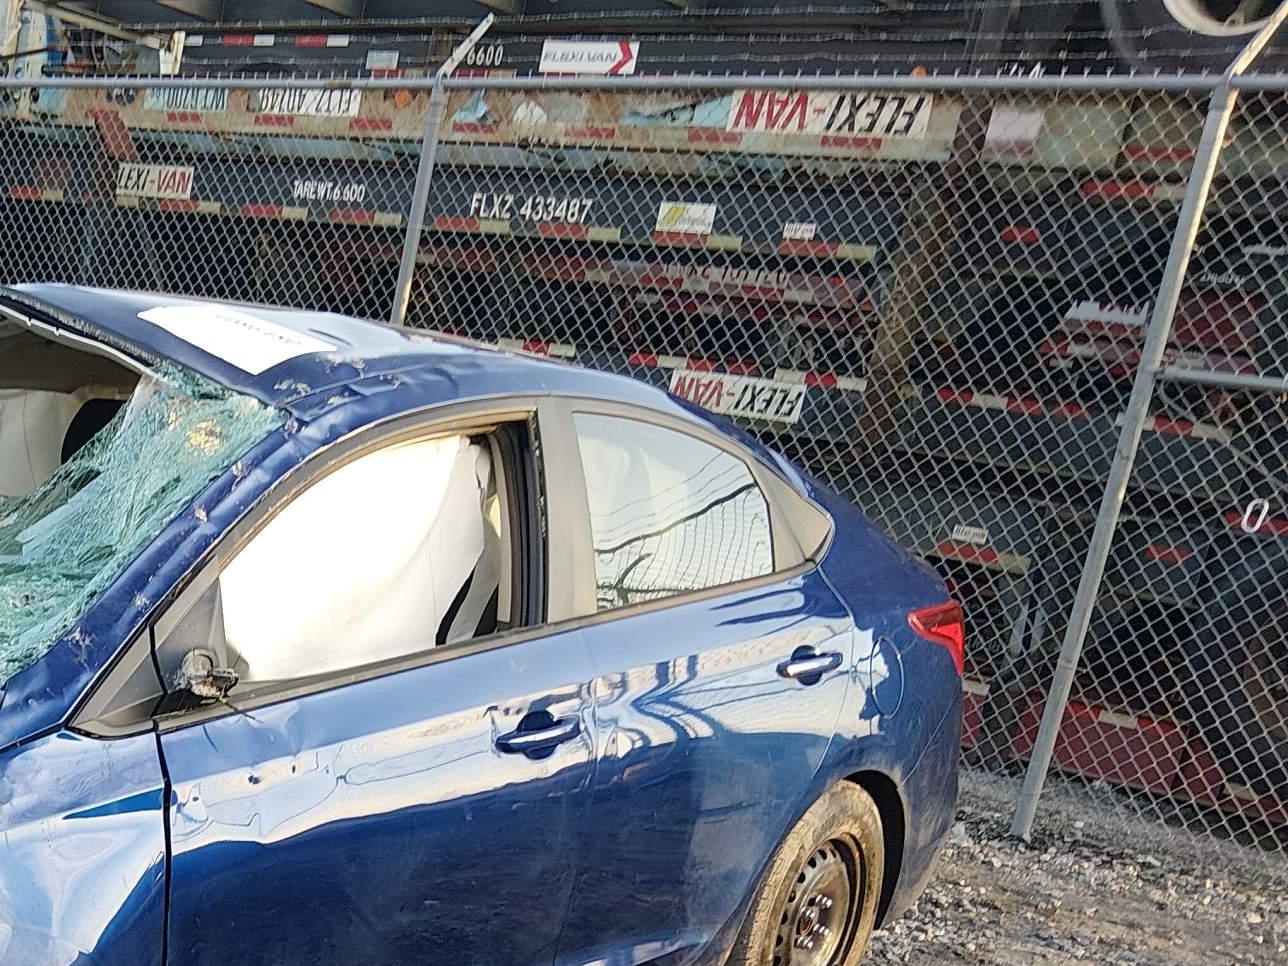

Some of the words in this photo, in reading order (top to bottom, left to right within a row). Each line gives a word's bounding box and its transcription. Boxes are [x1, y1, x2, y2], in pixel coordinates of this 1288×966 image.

[466, 45, 504, 66] 6600
[116, 167, 193, 194] LEXI-VAN
[469, 191, 515, 219] FLXZ
[519, 194, 593, 224] 433487
